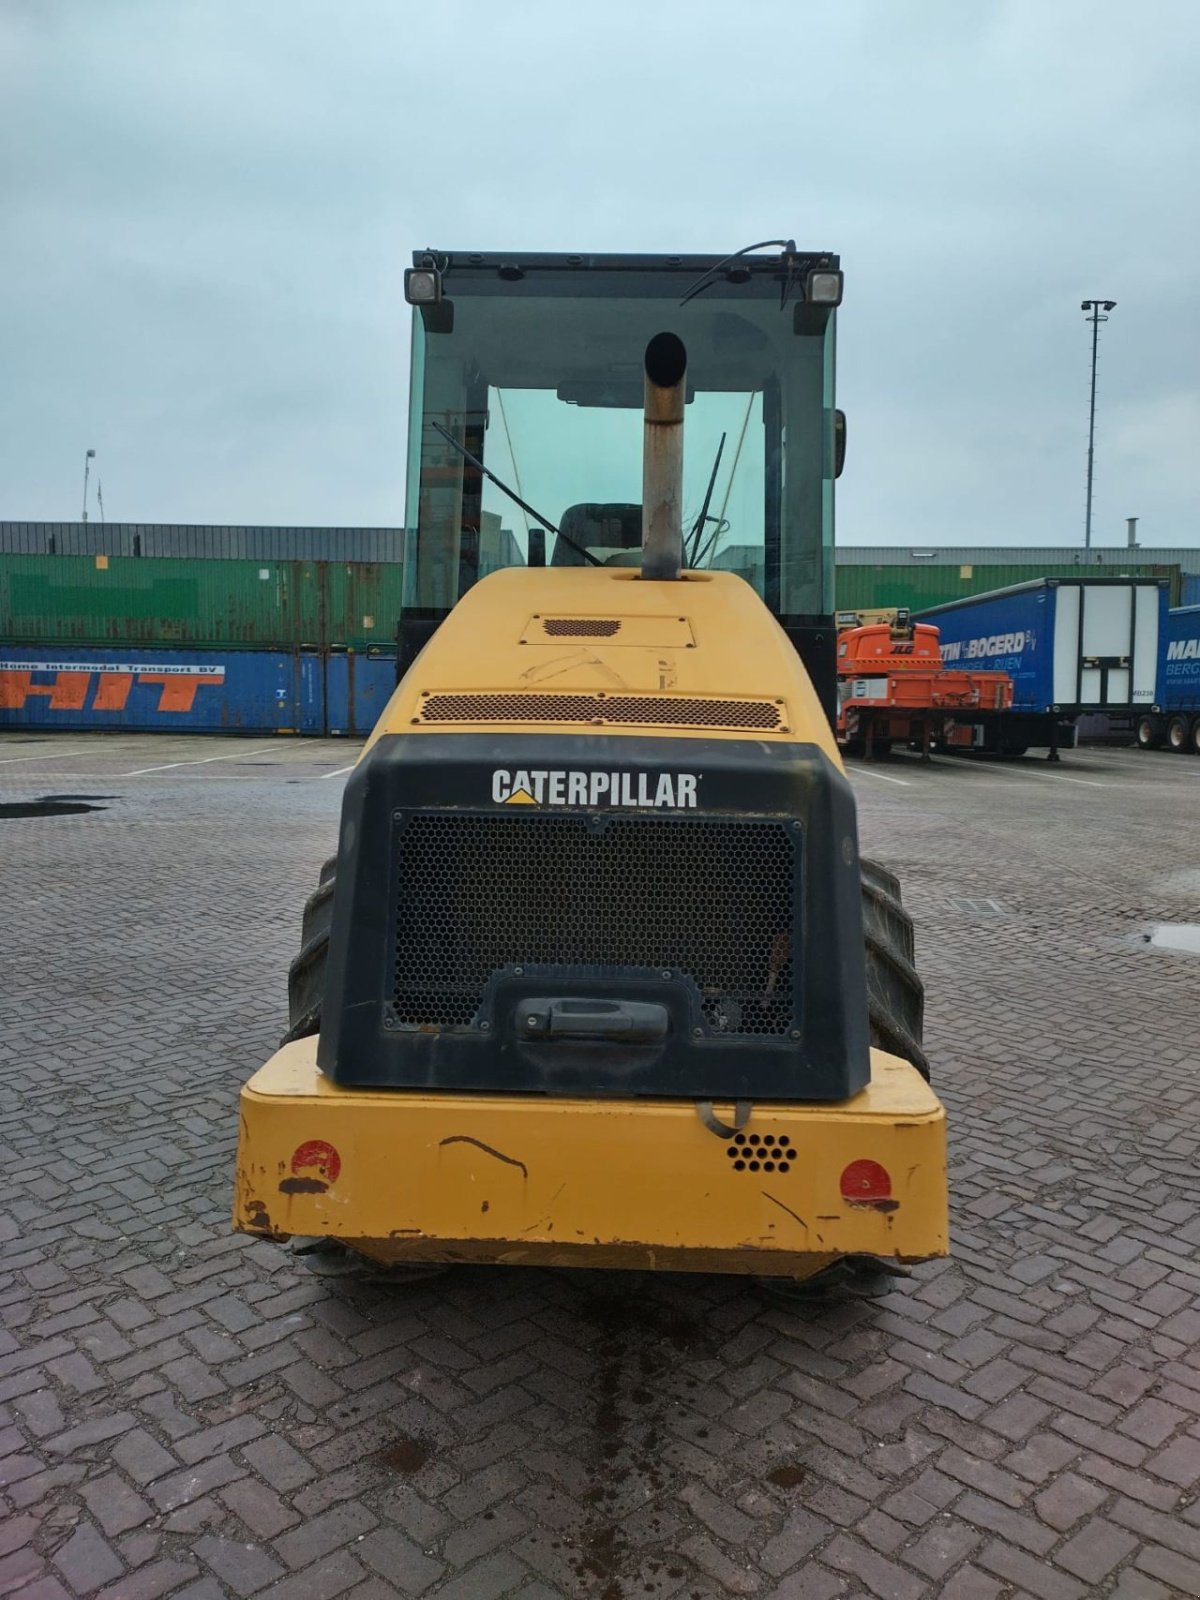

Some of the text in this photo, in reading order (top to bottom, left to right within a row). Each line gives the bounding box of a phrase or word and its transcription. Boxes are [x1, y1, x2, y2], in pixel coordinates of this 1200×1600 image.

[890, 645, 915, 655] JLG
[968, 632, 1025, 659] BOGERD
[1166, 639, 1200, 661] MA
[0, 662, 39, 670] Home
[127, 665, 192, 673] Transport
[0, 670, 225, 712] HIT
[492, 769, 698, 808] CATERPILLAR
